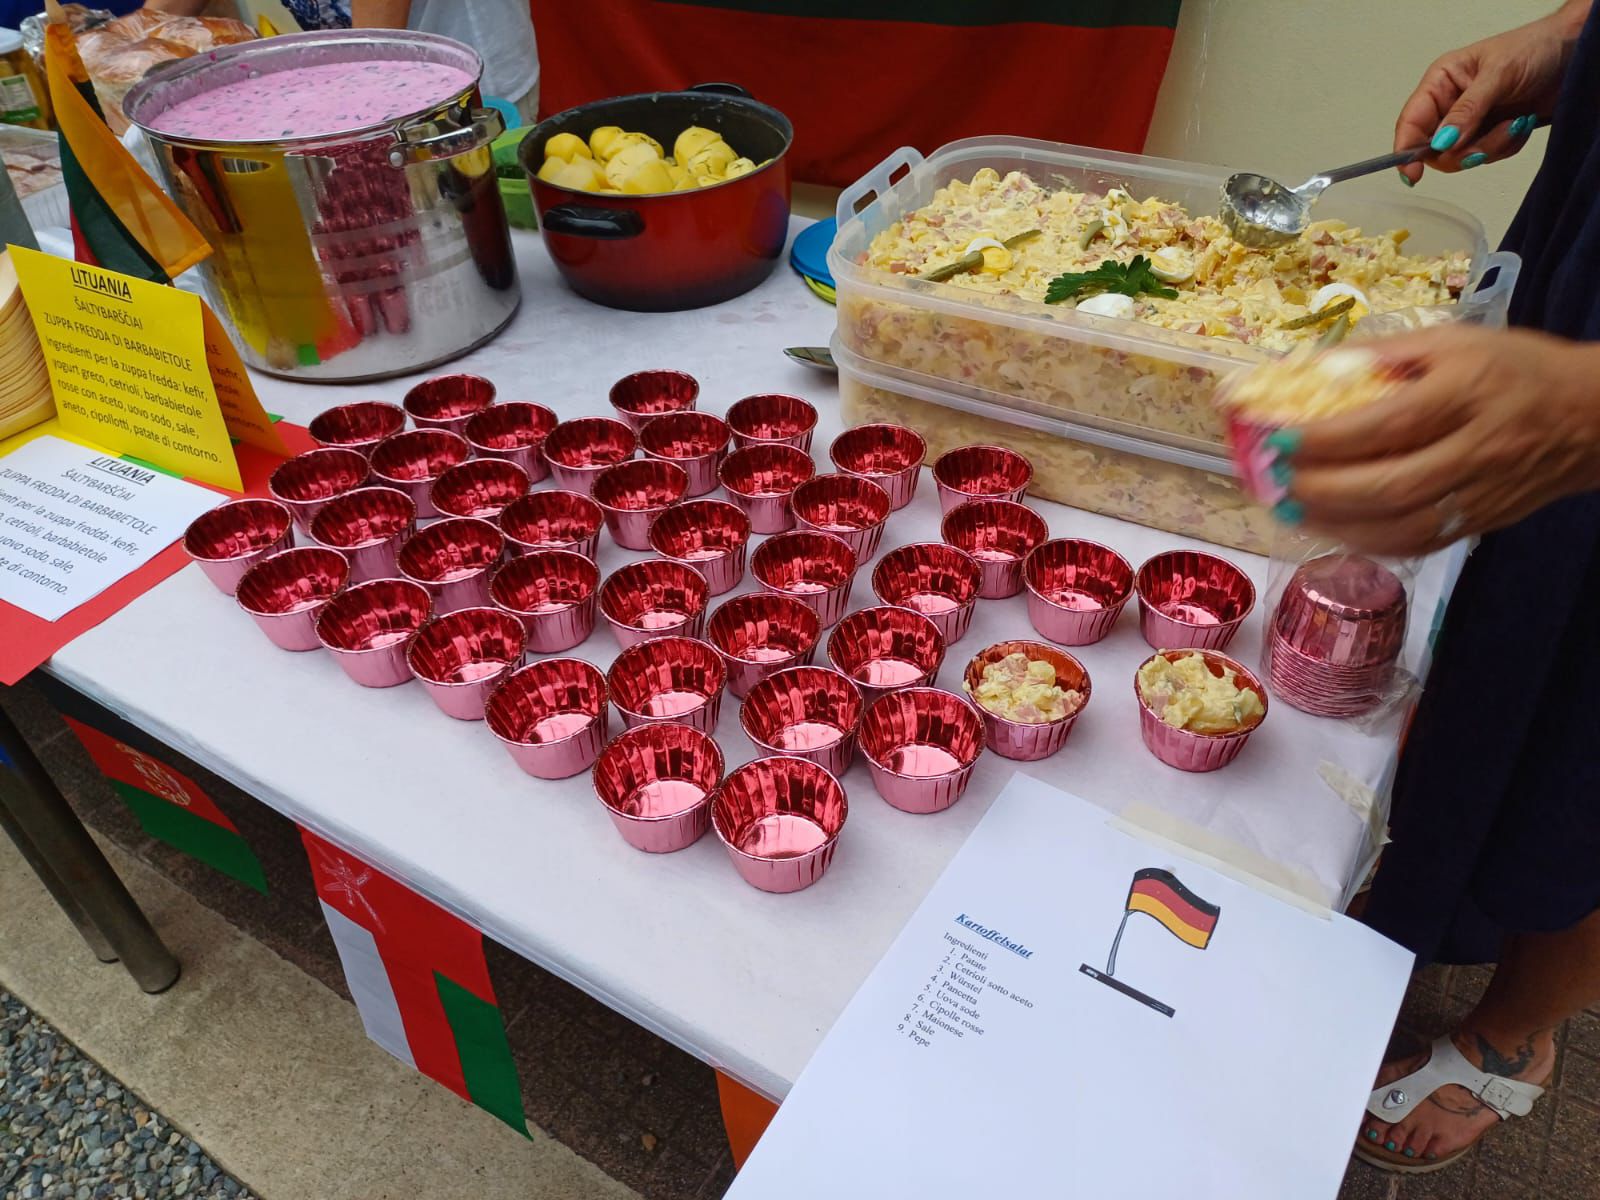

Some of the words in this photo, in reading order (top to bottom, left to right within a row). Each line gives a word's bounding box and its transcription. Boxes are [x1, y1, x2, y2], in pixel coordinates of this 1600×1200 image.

[71, 267, 132, 299] LITUANIA
[44, 312, 73, 331] ZUPPA
[74, 322, 111, 342] FREDDA
[112, 334, 122, 346] DI
[124, 338, 192, 371] BARBABIETOLE
[46, 336, 92, 360] Ingredienti
[94, 353, 108, 365] per
[109, 356, 119, 369] la
[121, 361, 147, 379] zuppa
[149, 370, 181, 392] fredda:
[182, 381, 208, 403] kefir,
[53, 359, 80, 375] yogurt
[81, 369, 108, 387] greco,
[110, 378, 143, 399] cetrioli,
[144, 388, 202, 418] barbabietole
[58, 379, 79, 394] rosse
[81, 388, 98, 400] con
[99, 394, 126, 412] aceto,
[127, 403, 149, 419] uovo
[150, 412, 175, 431] sodo,
[176, 423, 199, 439] sale,
[63, 400, 89, 418] aneto,
[90, 409, 132, 433] cipollotti,
[133, 425, 160, 443] patate
[162, 435, 170, 448] di
[172, 440, 222, 463] contorno.
[91, 457, 156, 483] LITUANIA
[0, 468, 32, 485] ZUPPA
[29, 480, 70, 500] FREDDA
[67, 495, 83, 504] DI
[80, 500, 157, 535] BARBABIETOLE
[5, 517, 44, 537] cetrioli,
[42, 531, 108, 563] barbabietole
[16, 499, 36, 511] per
[33, 505, 46, 515] la
[43, 511, 76, 527] zuppa
[74, 521, 112, 541] fredda:
[110, 536, 139, 556] kefir,
[0, 536, 24, 550] uovo
[22, 546, 49, 563] sodo,
[49, 558, 74, 574] sale,
[7, 563, 24, 573] di
[19, 568, 68, 596] contorno.
[944, 931, 989, 960] Ingredienti
[956, 913, 1033, 958] Kartoffelsalat
[936, 965, 944, 975] 3.
[949, 971, 983, 995] Würstel
[960, 952, 987, 972] Patate
[930, 974, 938, 984] 4.
[942, 980, 977, 1005] Pancetta
[942, 955, 950, 965] 2.
[955, 962, 987, 984] Cetrioli
[987, 980, 1009, 996] sotto
[1009, 993, 1033, 1009] aceto
[911, 1003, 918, 1013] 7.
[922, 1010, 964, 1038] Maionese
[917, 994, 925, 1003] 6.
[929, 1000, 961, 1023] Cipolle
[961, 1020, 985, 1035] rosse
[923, 984, 931, 993] 5.
[936, 990, 958, 1008] Uova
[959, 1004, 980, 1020] sode
[897, 1023, 904, 1033] 9.
[908, 1030, 931, 1047] Pepe
[903, 1013, 911, 1023] 8.
[915, 1020, 935, 1035] Sale
